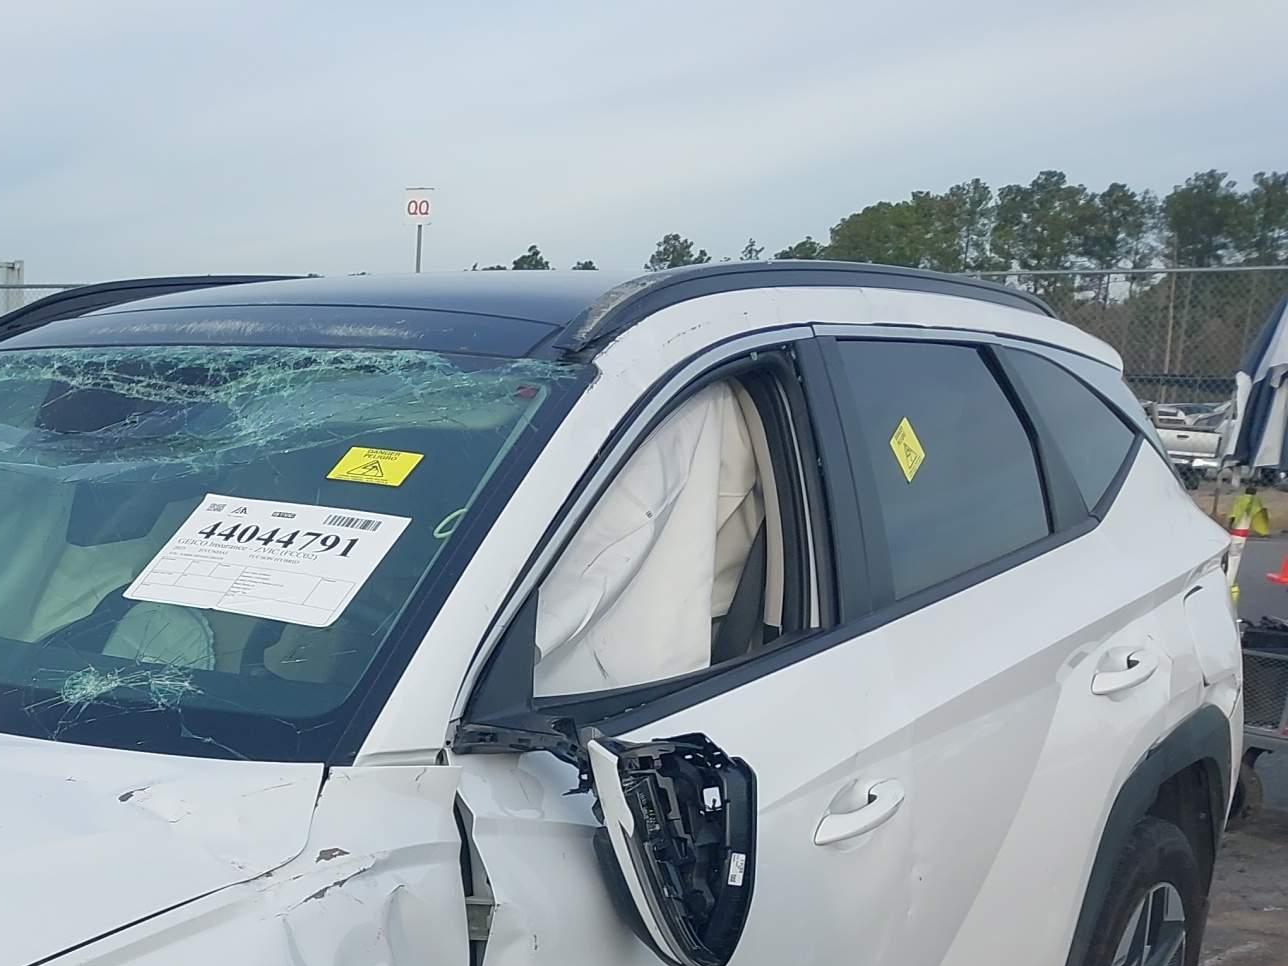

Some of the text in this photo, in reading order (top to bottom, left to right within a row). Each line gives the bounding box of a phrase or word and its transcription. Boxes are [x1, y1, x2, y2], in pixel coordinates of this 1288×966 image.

[407, 199, 430, 216] QQ
[363, 453, 398, 461] PELIGRO
[367, 449, 401, 457] DANGER
[177, 538, 209, 546] GEICO
[208, 541, 249, 551] Insurance
[197, 521, 359, 558] 44044791
